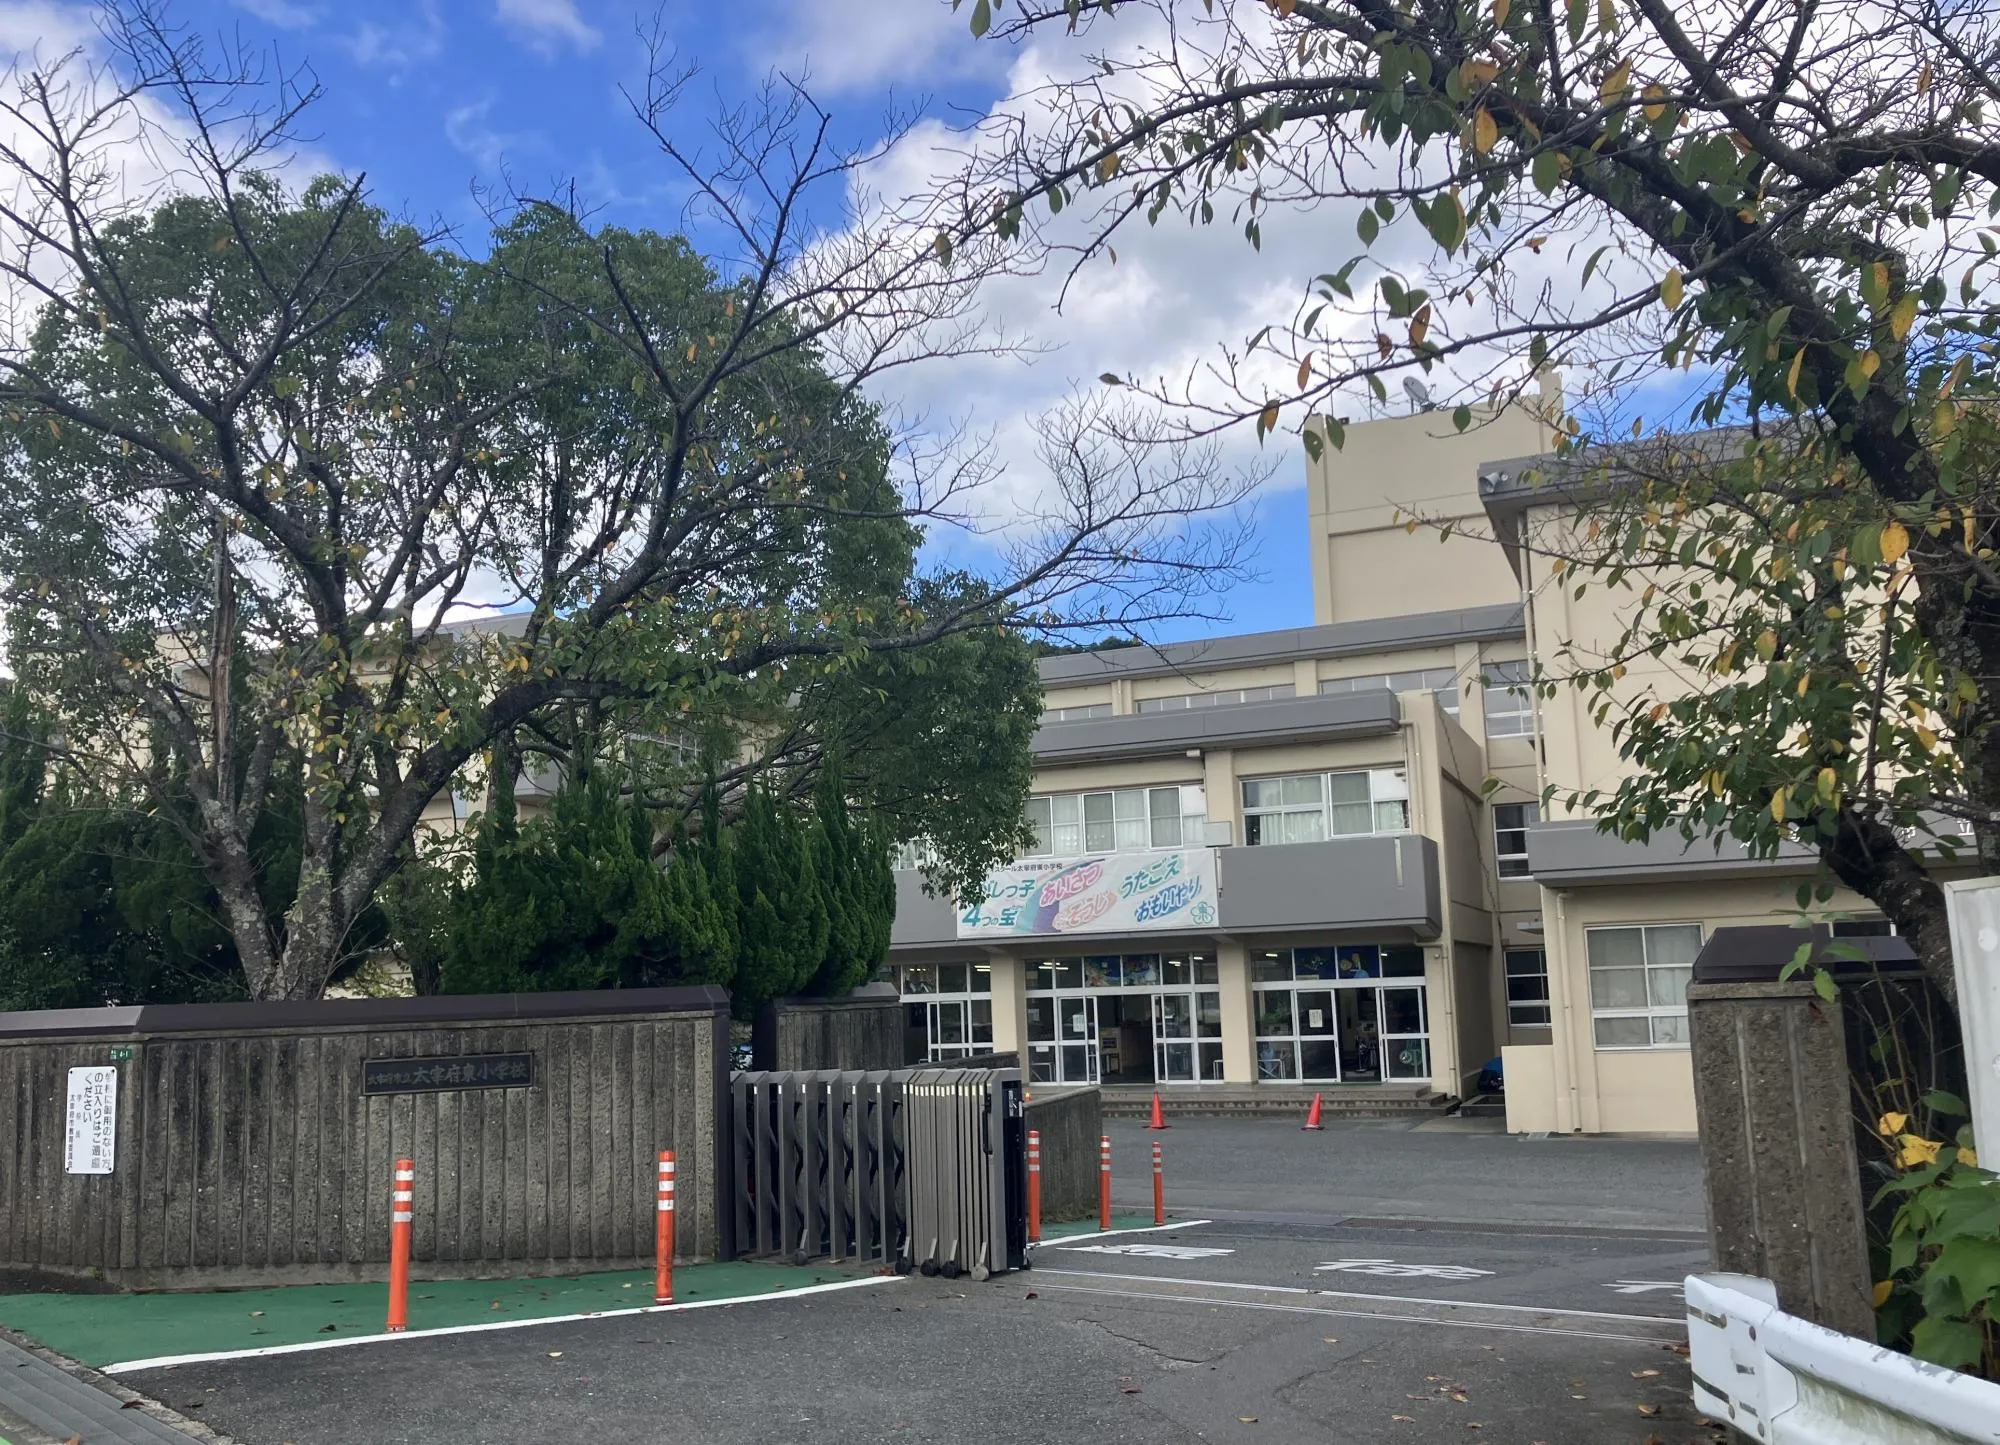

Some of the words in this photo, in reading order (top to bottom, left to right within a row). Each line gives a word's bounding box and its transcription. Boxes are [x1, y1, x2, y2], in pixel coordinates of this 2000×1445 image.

[1040, 863, 1101, 907] あいさつ
[1120, 854, 1181, 900] うたごえ
[1134, 874, 1200, 922] おもいやり
[83, 1072, 92, 1123] ください
